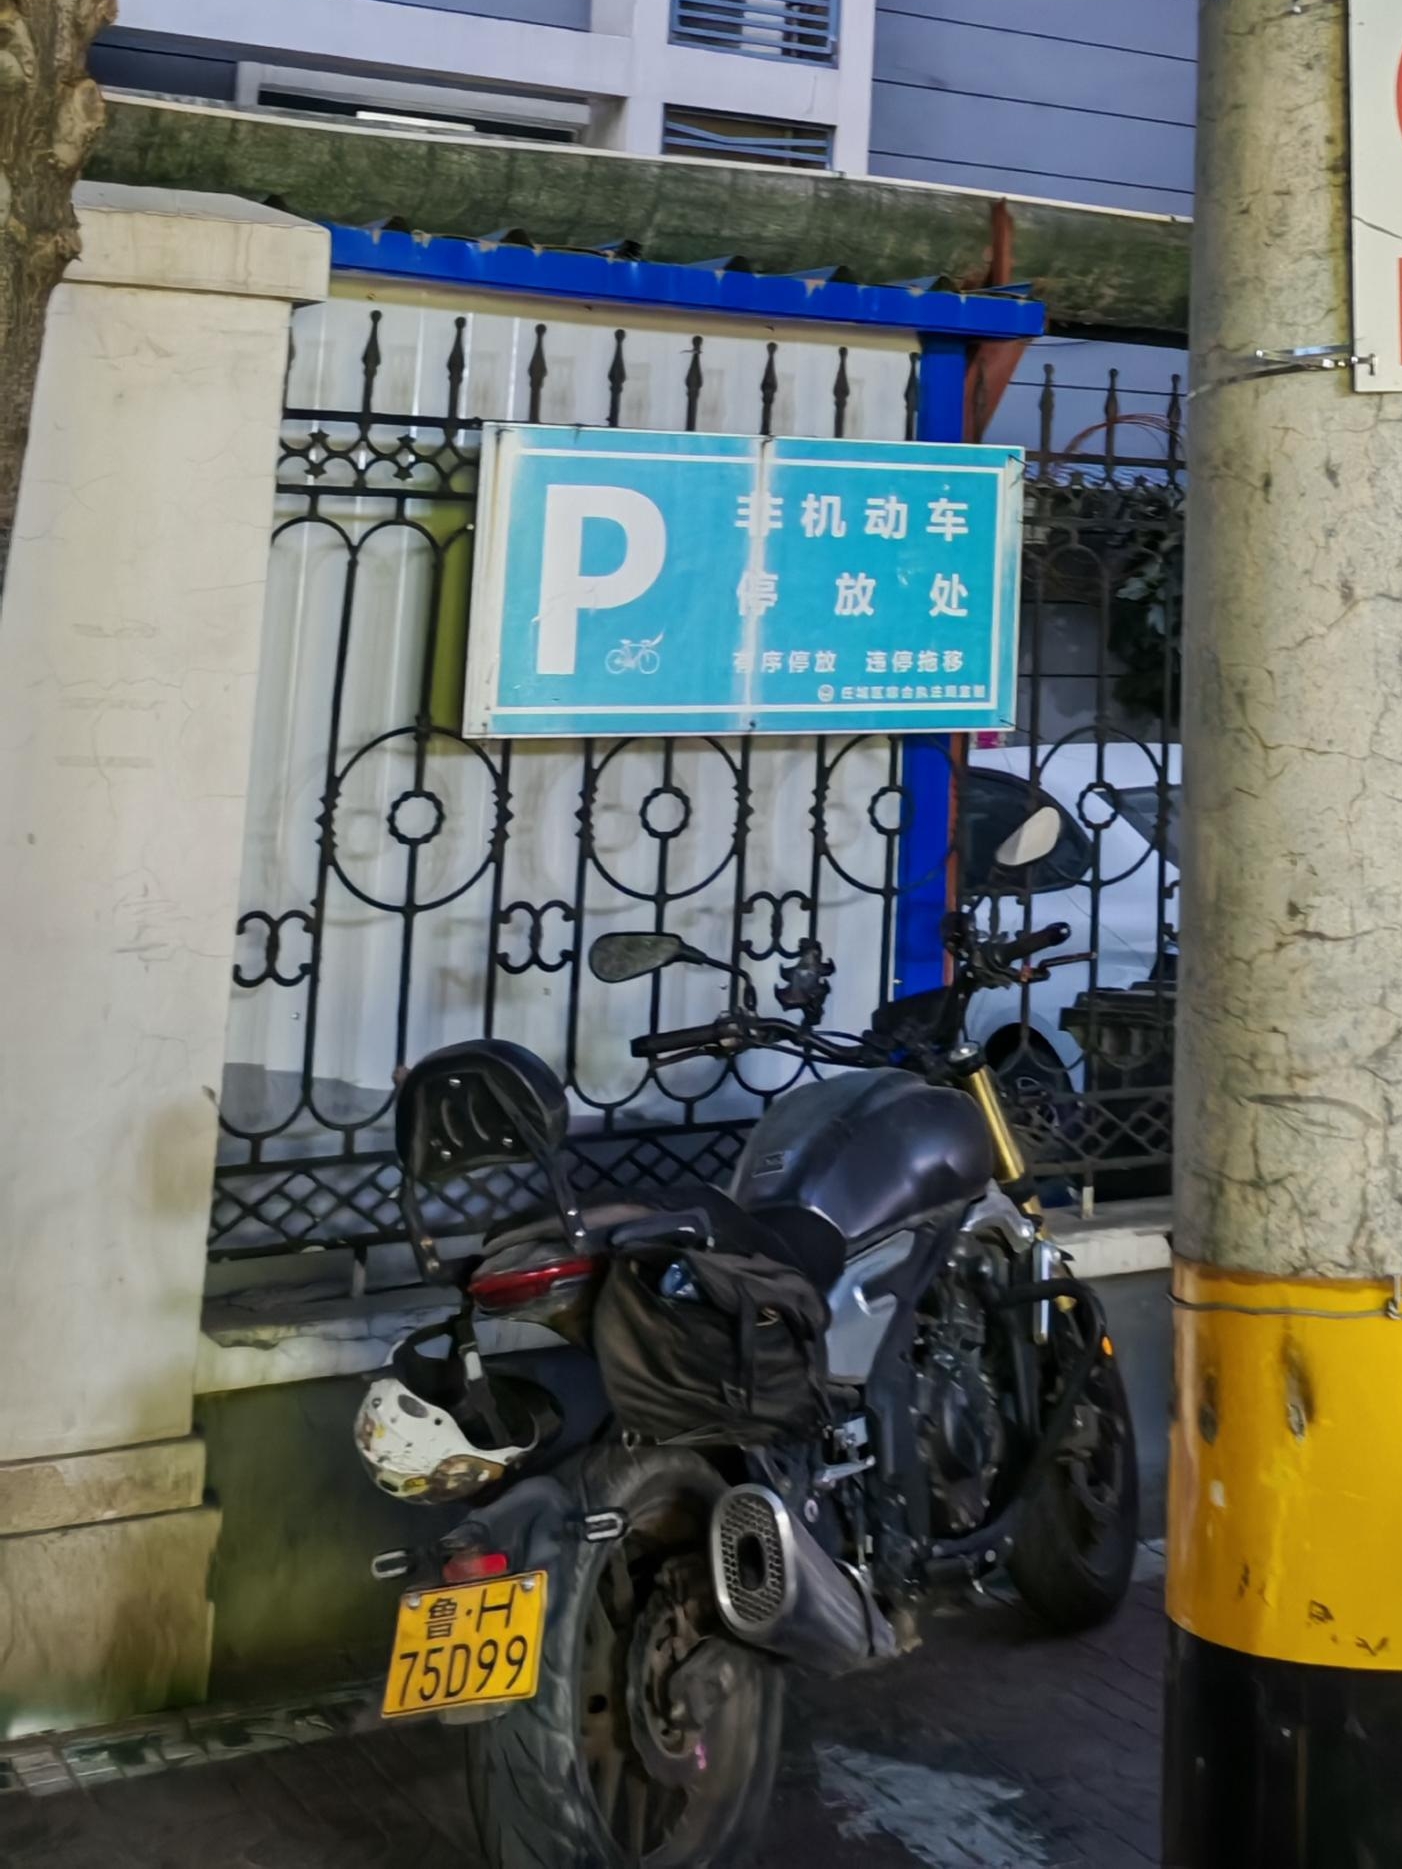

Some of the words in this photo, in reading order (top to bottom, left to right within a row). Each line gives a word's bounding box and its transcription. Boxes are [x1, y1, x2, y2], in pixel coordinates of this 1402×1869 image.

[735, 493, 969, 542] 非机动车
[536, 484, 667, 675] P
[736, 571, 968, 618] 停放处
[399, 1634, 528, 1707] 75D99
